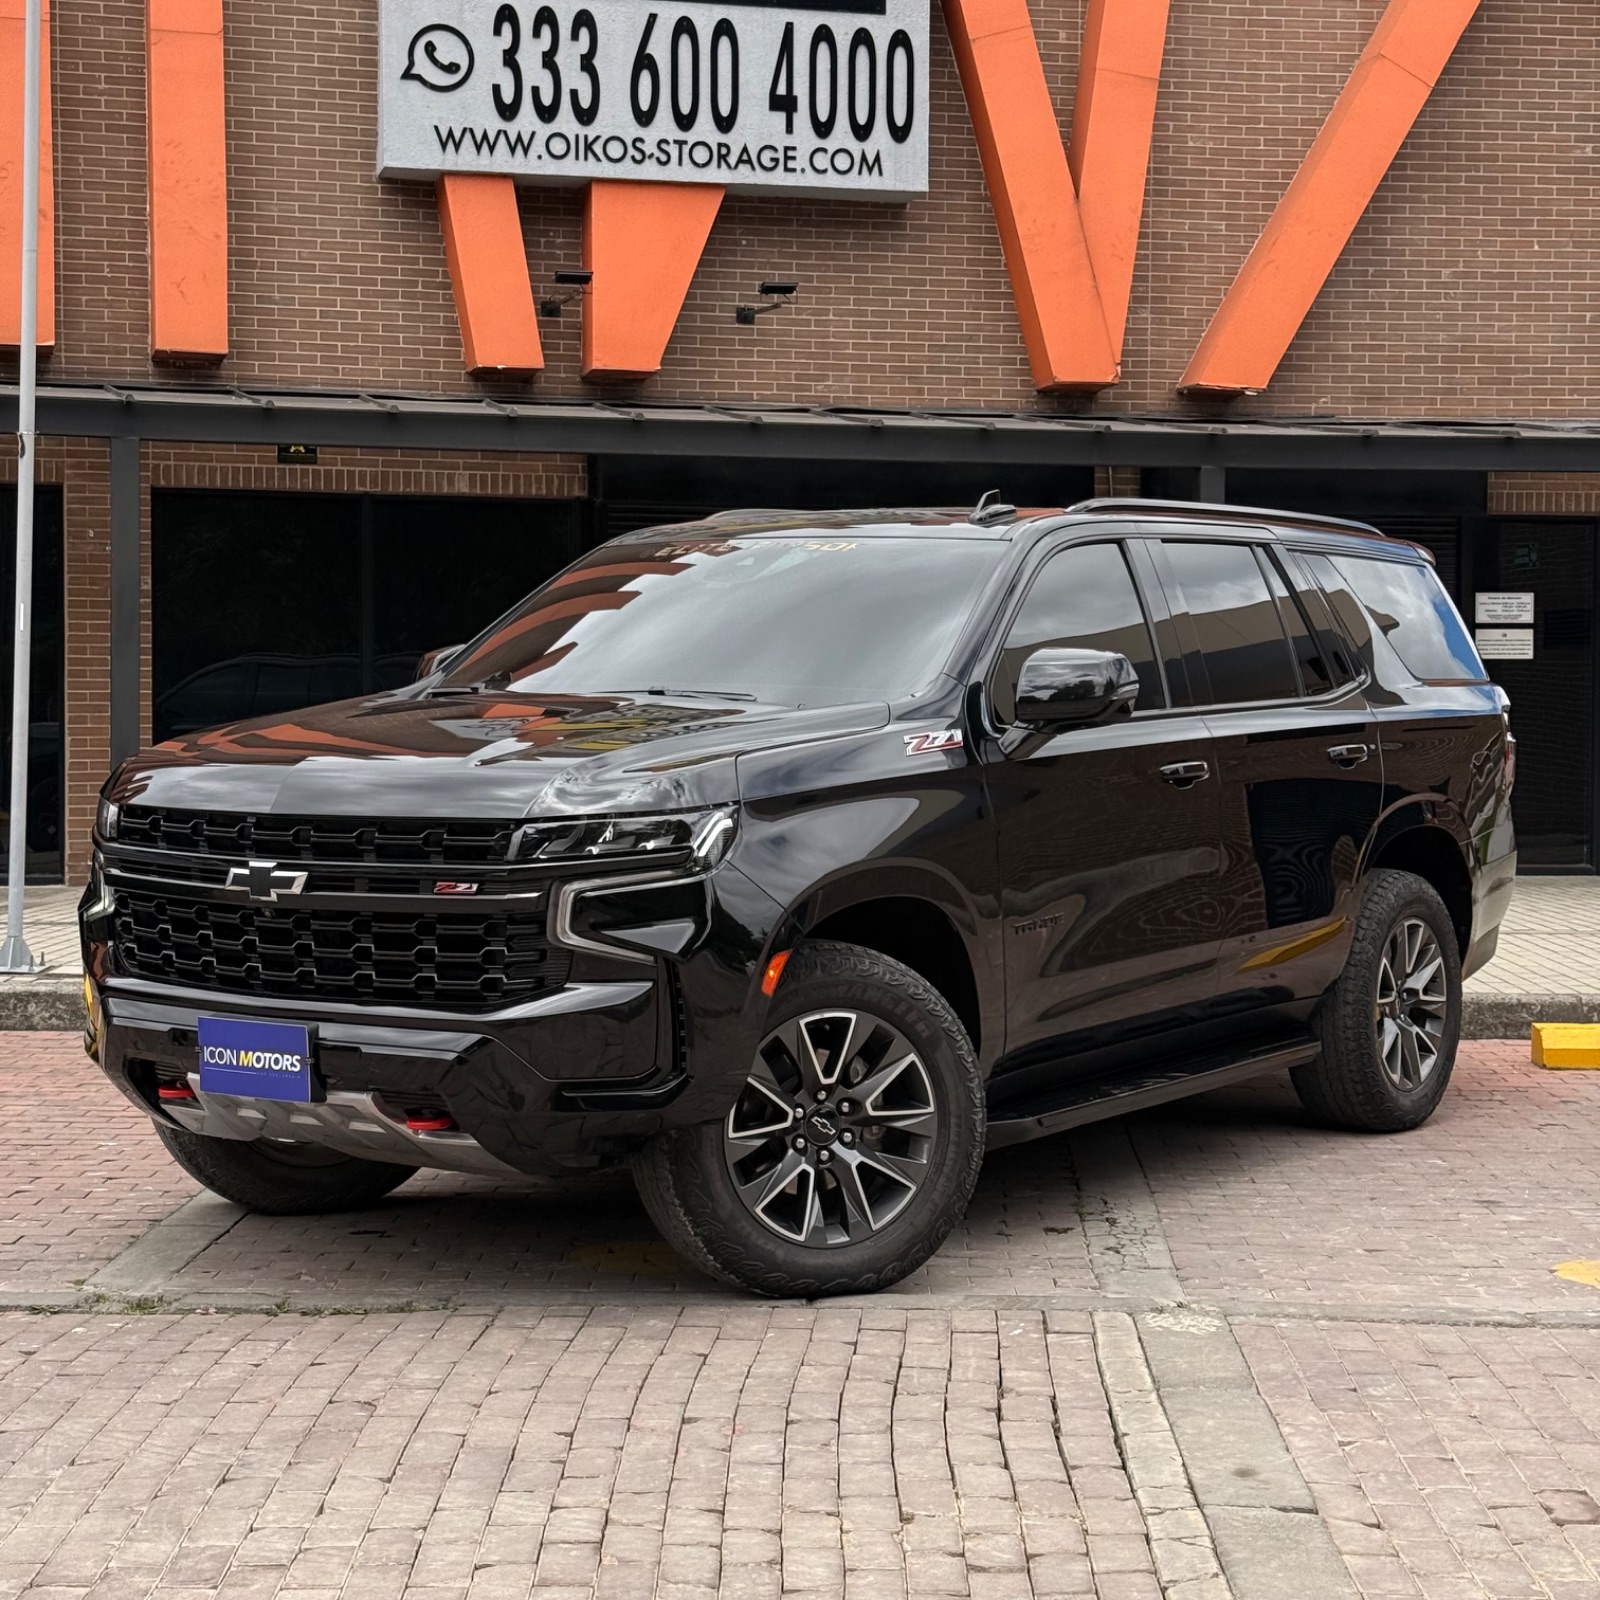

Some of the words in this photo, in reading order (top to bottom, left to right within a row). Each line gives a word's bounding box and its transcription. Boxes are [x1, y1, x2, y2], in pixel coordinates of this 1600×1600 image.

[491, 3, 602, 126] 333
[630, 13, 740, 133] 600
[768, 21, 915, 144] 4000
[433, 125, 884, 177] WWW.OIKOS-STORAGE.COM
[903, 728, 964, 757] Z71
[433, 881, 479, 894] Z71
[203, 1046, 237, 1066] ICON
[239, 1050, 302, 1072] MOTORS
